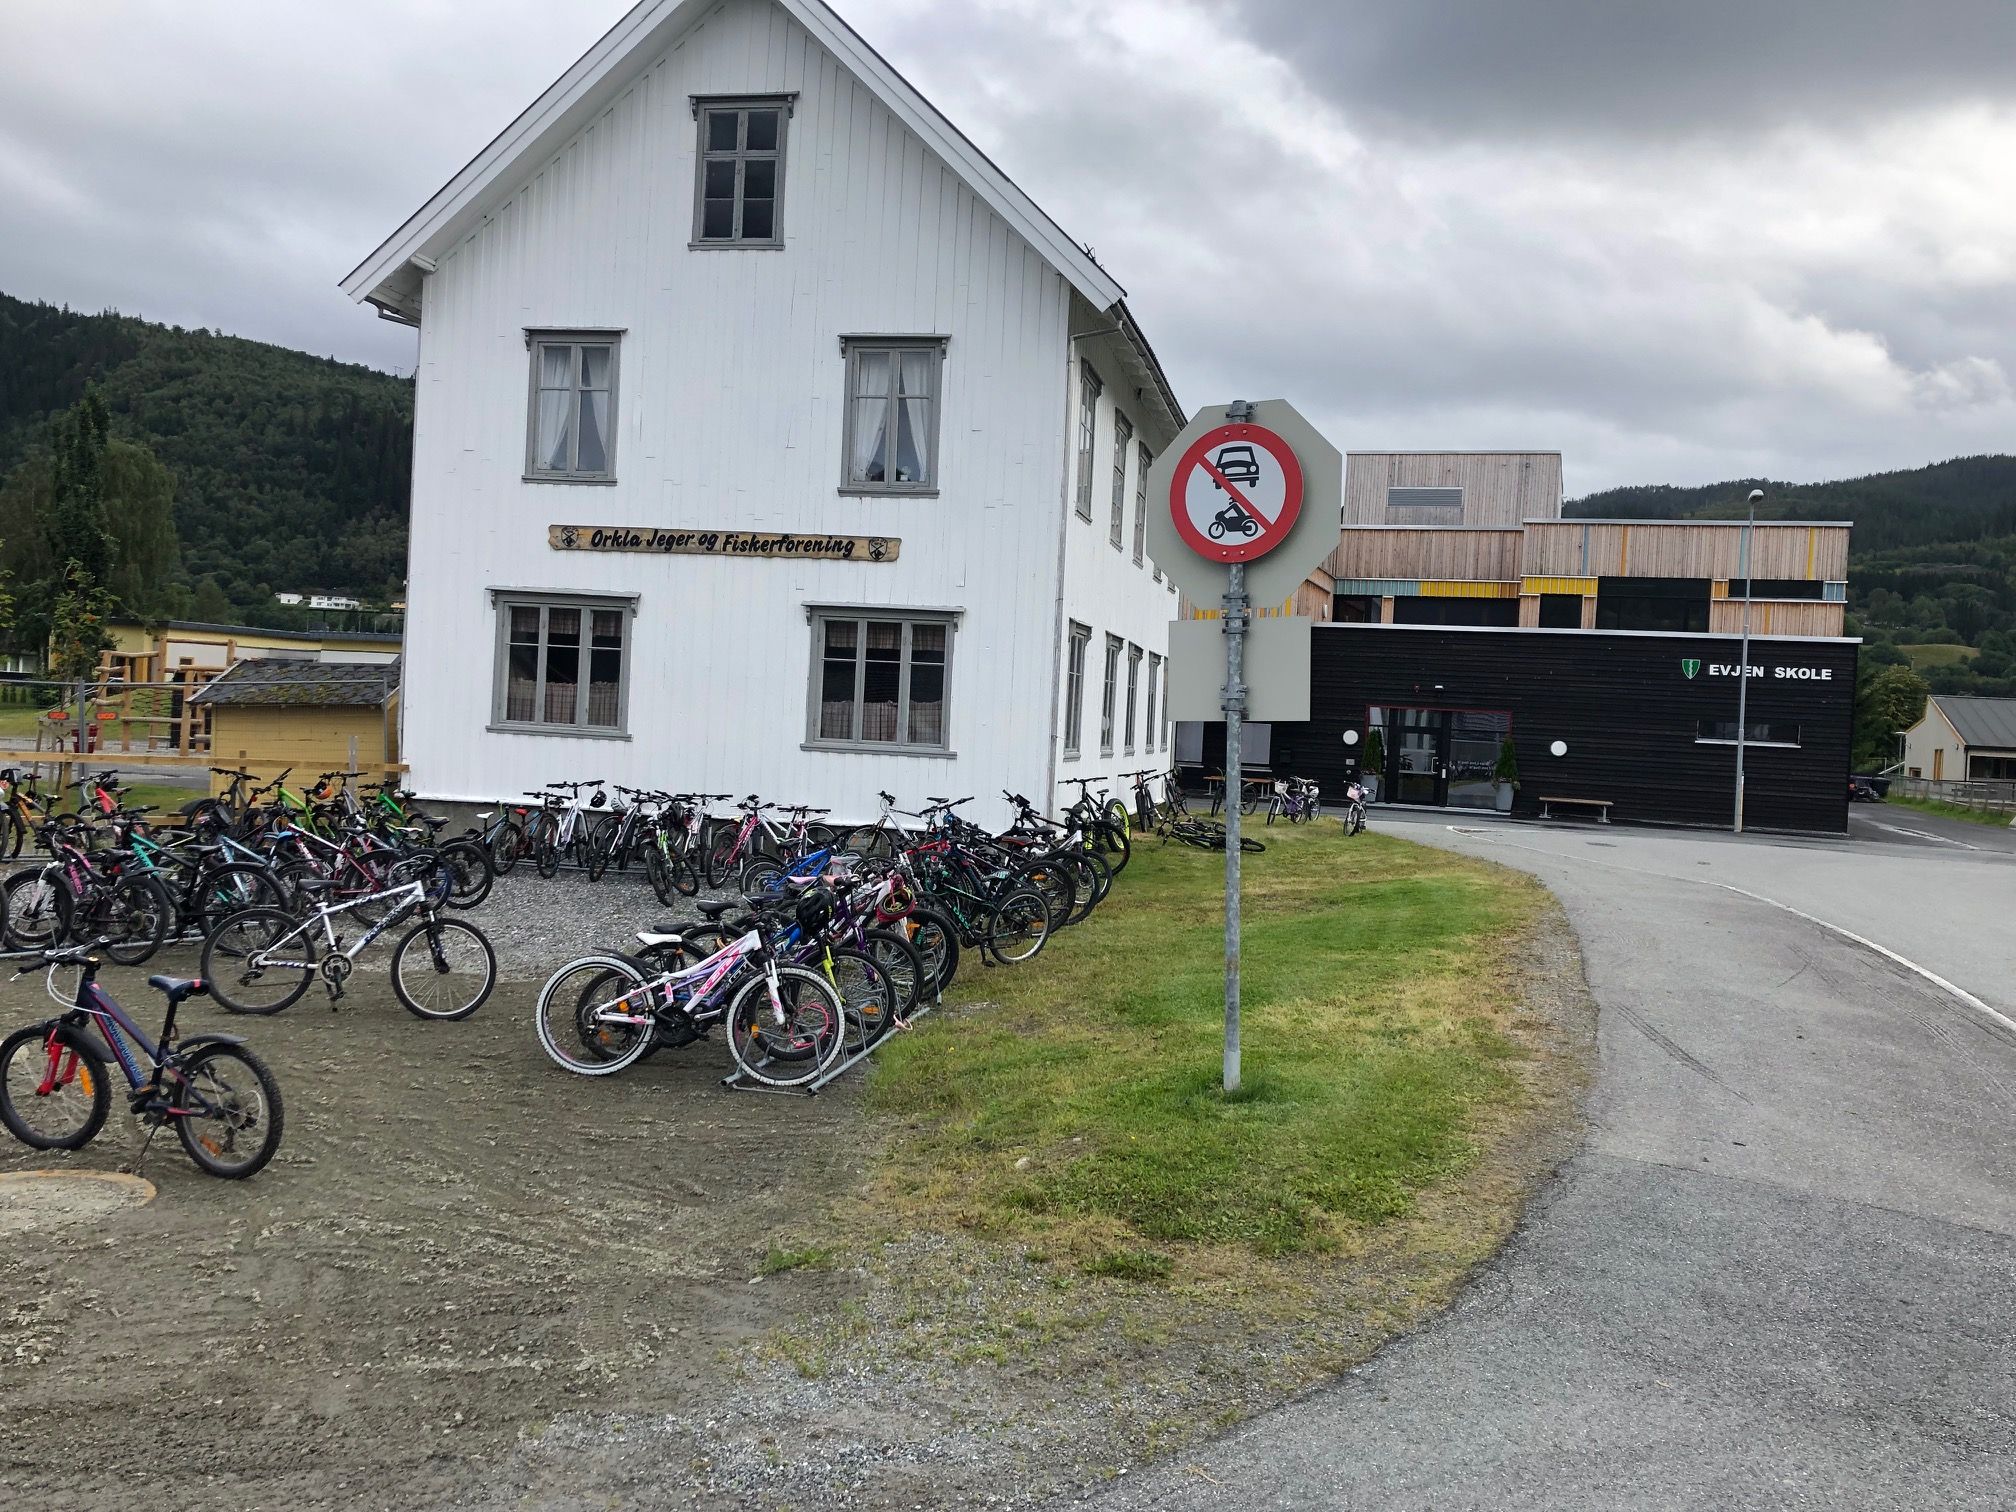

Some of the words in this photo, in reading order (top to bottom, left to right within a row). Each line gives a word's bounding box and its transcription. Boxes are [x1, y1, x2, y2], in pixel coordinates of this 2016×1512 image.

[591, 529, 642, 548] Orkla
[647, 528, 695, 552] Jeger
[697, 533, 719, 552] og
[722, 533, 855, 558] Fiskerforening
[1709, 664, 1764, 677] EVJEN
[1774, 666, 1832, 680] SKOLE
